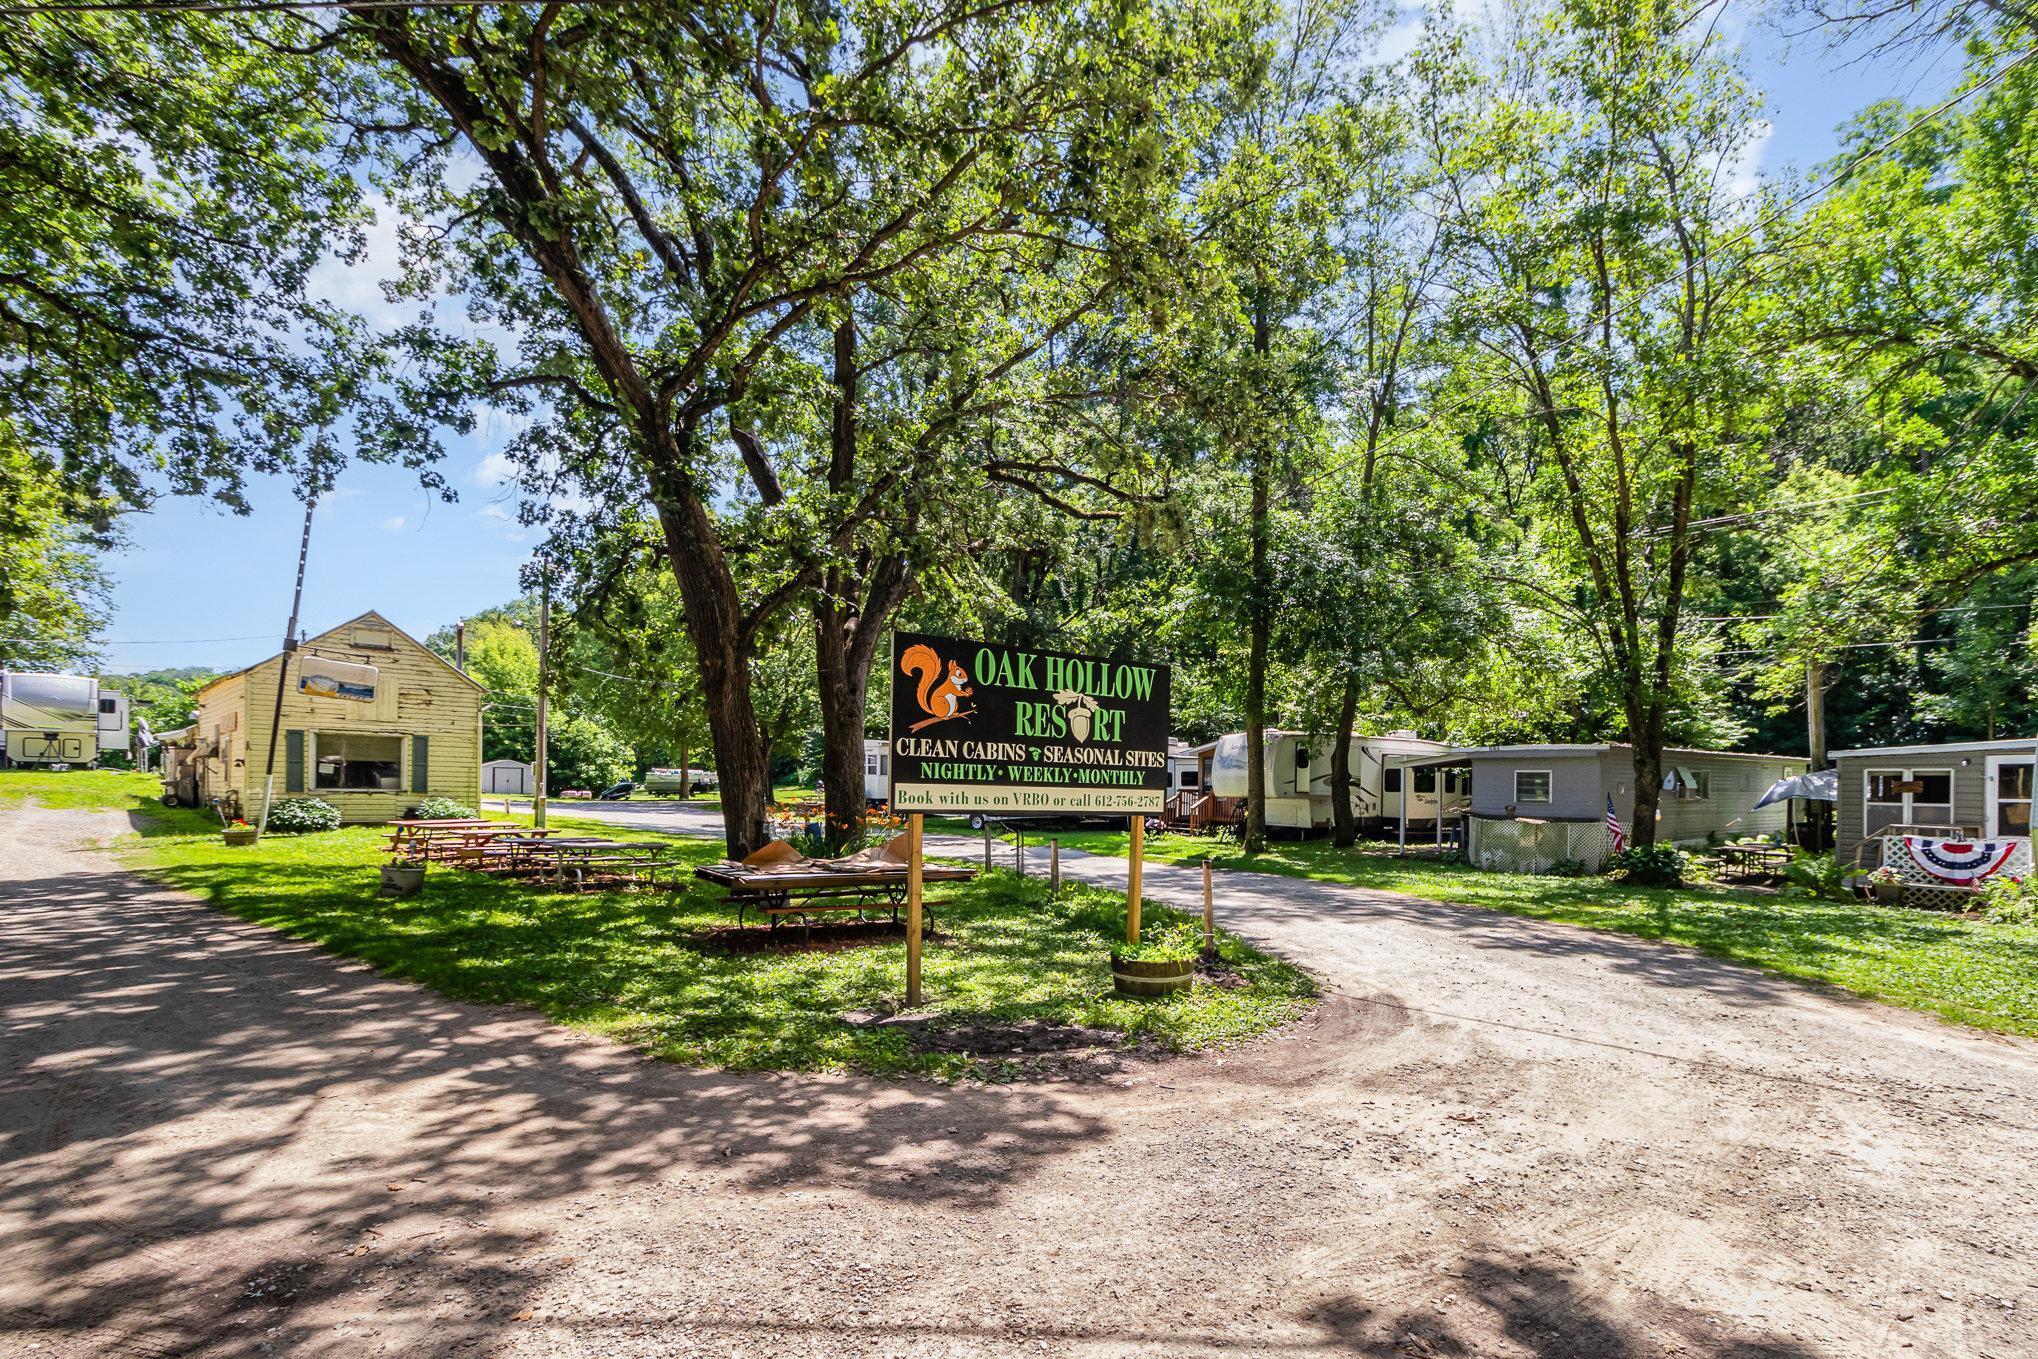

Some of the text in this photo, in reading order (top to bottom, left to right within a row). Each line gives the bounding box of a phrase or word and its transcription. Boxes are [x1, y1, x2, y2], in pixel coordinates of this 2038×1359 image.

[974, 647, 1157, 702] OAK HOLLOW
[896, 737, 1026, 761] CLEAN CABINS
[1043, 746, 1165, 768] SEASONAL SITES
[920, 762, 1146, 786] NIGHTLY WEEKLY MONTHLY
[897, 790, 1160, 808] Book with us on VRBO or call 612-756-2787
